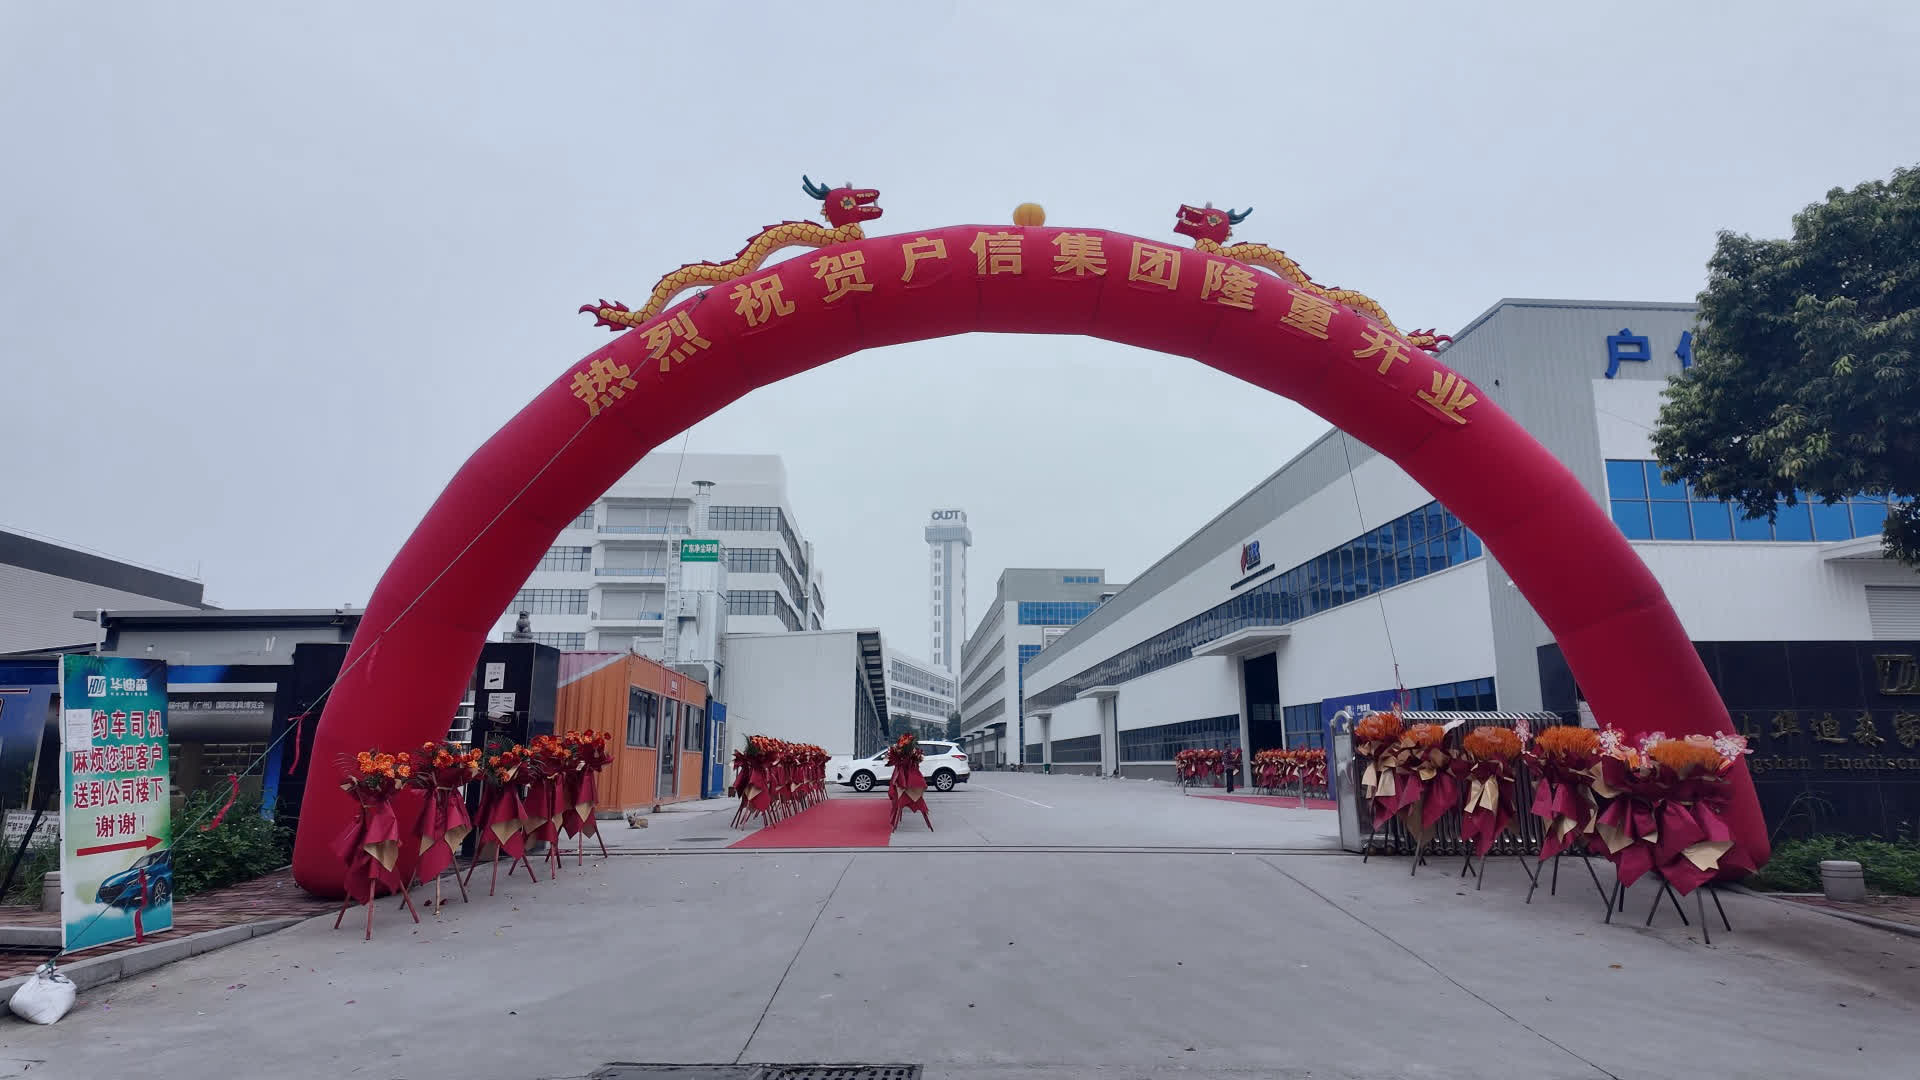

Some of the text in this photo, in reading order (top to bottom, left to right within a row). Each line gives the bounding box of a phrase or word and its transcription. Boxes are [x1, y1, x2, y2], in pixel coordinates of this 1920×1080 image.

[570, 231, 1478, 425] 热烈祝贺户信集团隆重开业
[110, 677, 149, 692] 华迪森
[92, 709, 164, 739] 约车司机
[73, 743, 163, 774] 麻烦您把客户
[73, 777, 163, 809] 送到公司楼下
